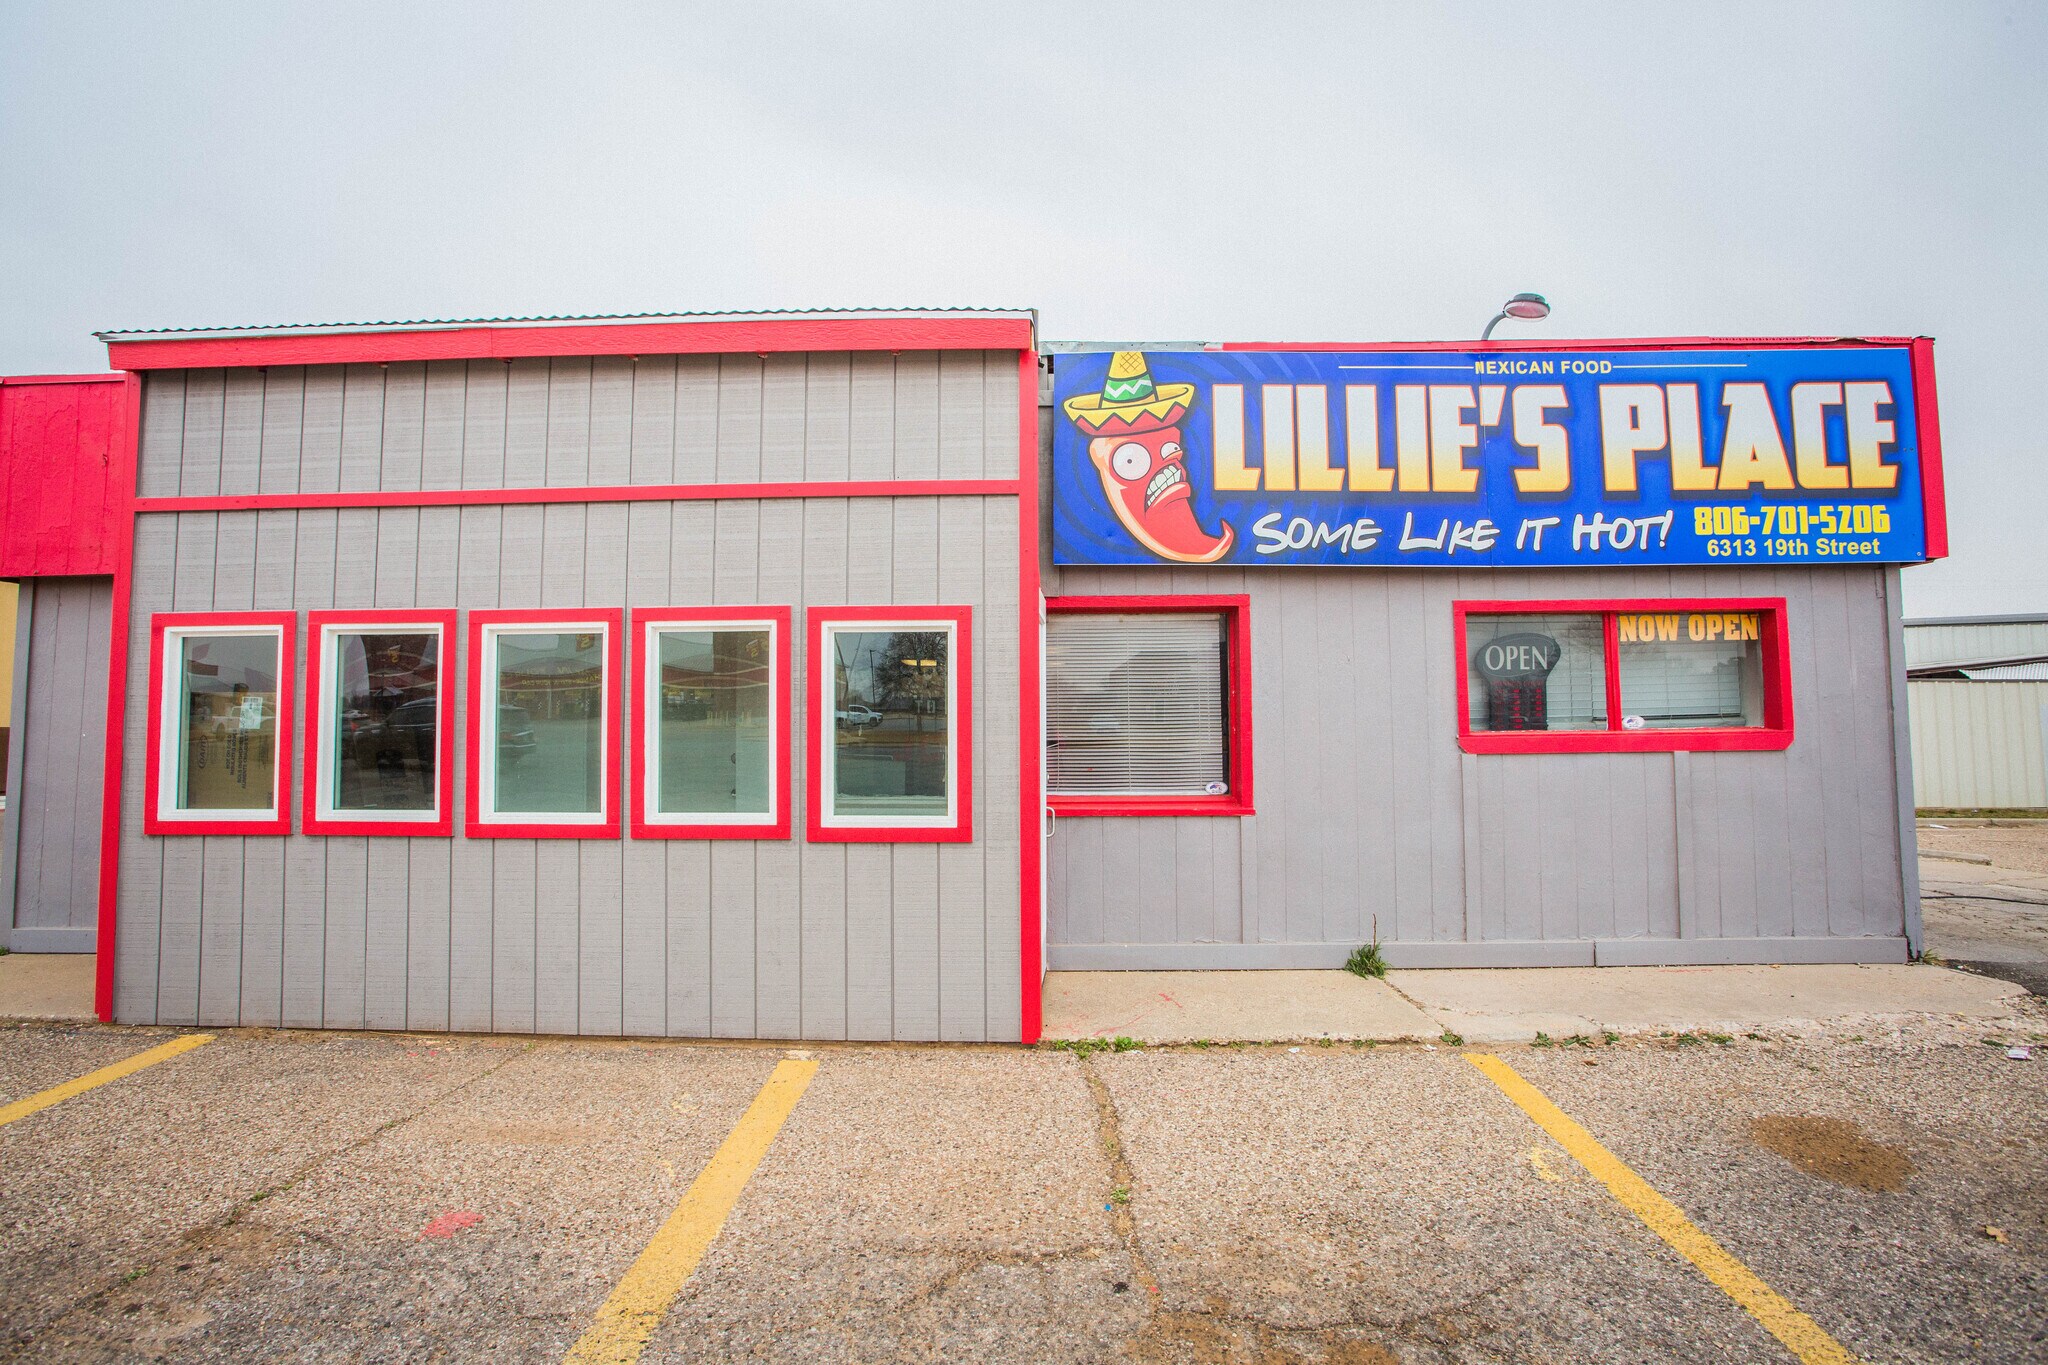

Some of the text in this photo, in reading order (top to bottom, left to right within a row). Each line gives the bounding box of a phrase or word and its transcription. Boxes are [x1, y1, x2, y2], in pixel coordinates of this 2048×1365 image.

[1475, 360, 1613, 376] MEXICAN FOOD
[1212, 381, 1899, 494] LILLIE'S PLACE
[1252, 510, 1675, 555] SOME LIKE IT HOT!
[1694, 504, 1891, 536] 806-701-5206
[1707, 538, 1881, 557] 6313 19th Street
[1618, 613, 1760, 642] NOW OPEN
[1484, 645, 1549, 671] OPEN
